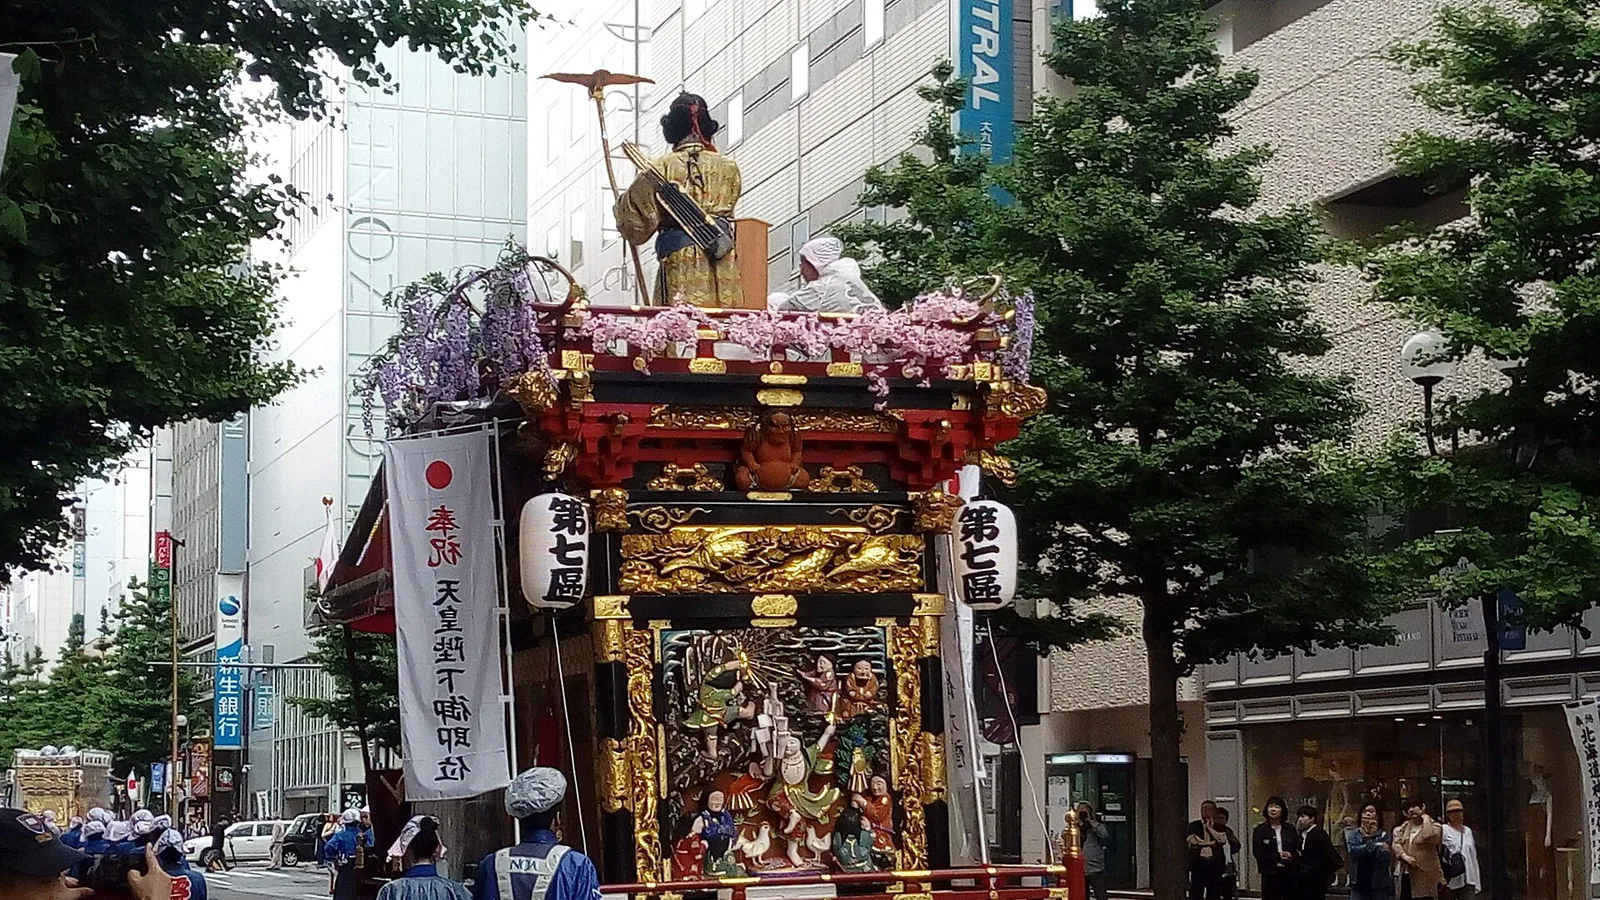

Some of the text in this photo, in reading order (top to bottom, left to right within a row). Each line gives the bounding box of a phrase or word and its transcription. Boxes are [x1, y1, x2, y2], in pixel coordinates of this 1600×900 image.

[972, 0, 1000, 110] TRAL
[958, 504, 1002, 604] 第七區
[218, 655, 239, 737] 新生銀行
